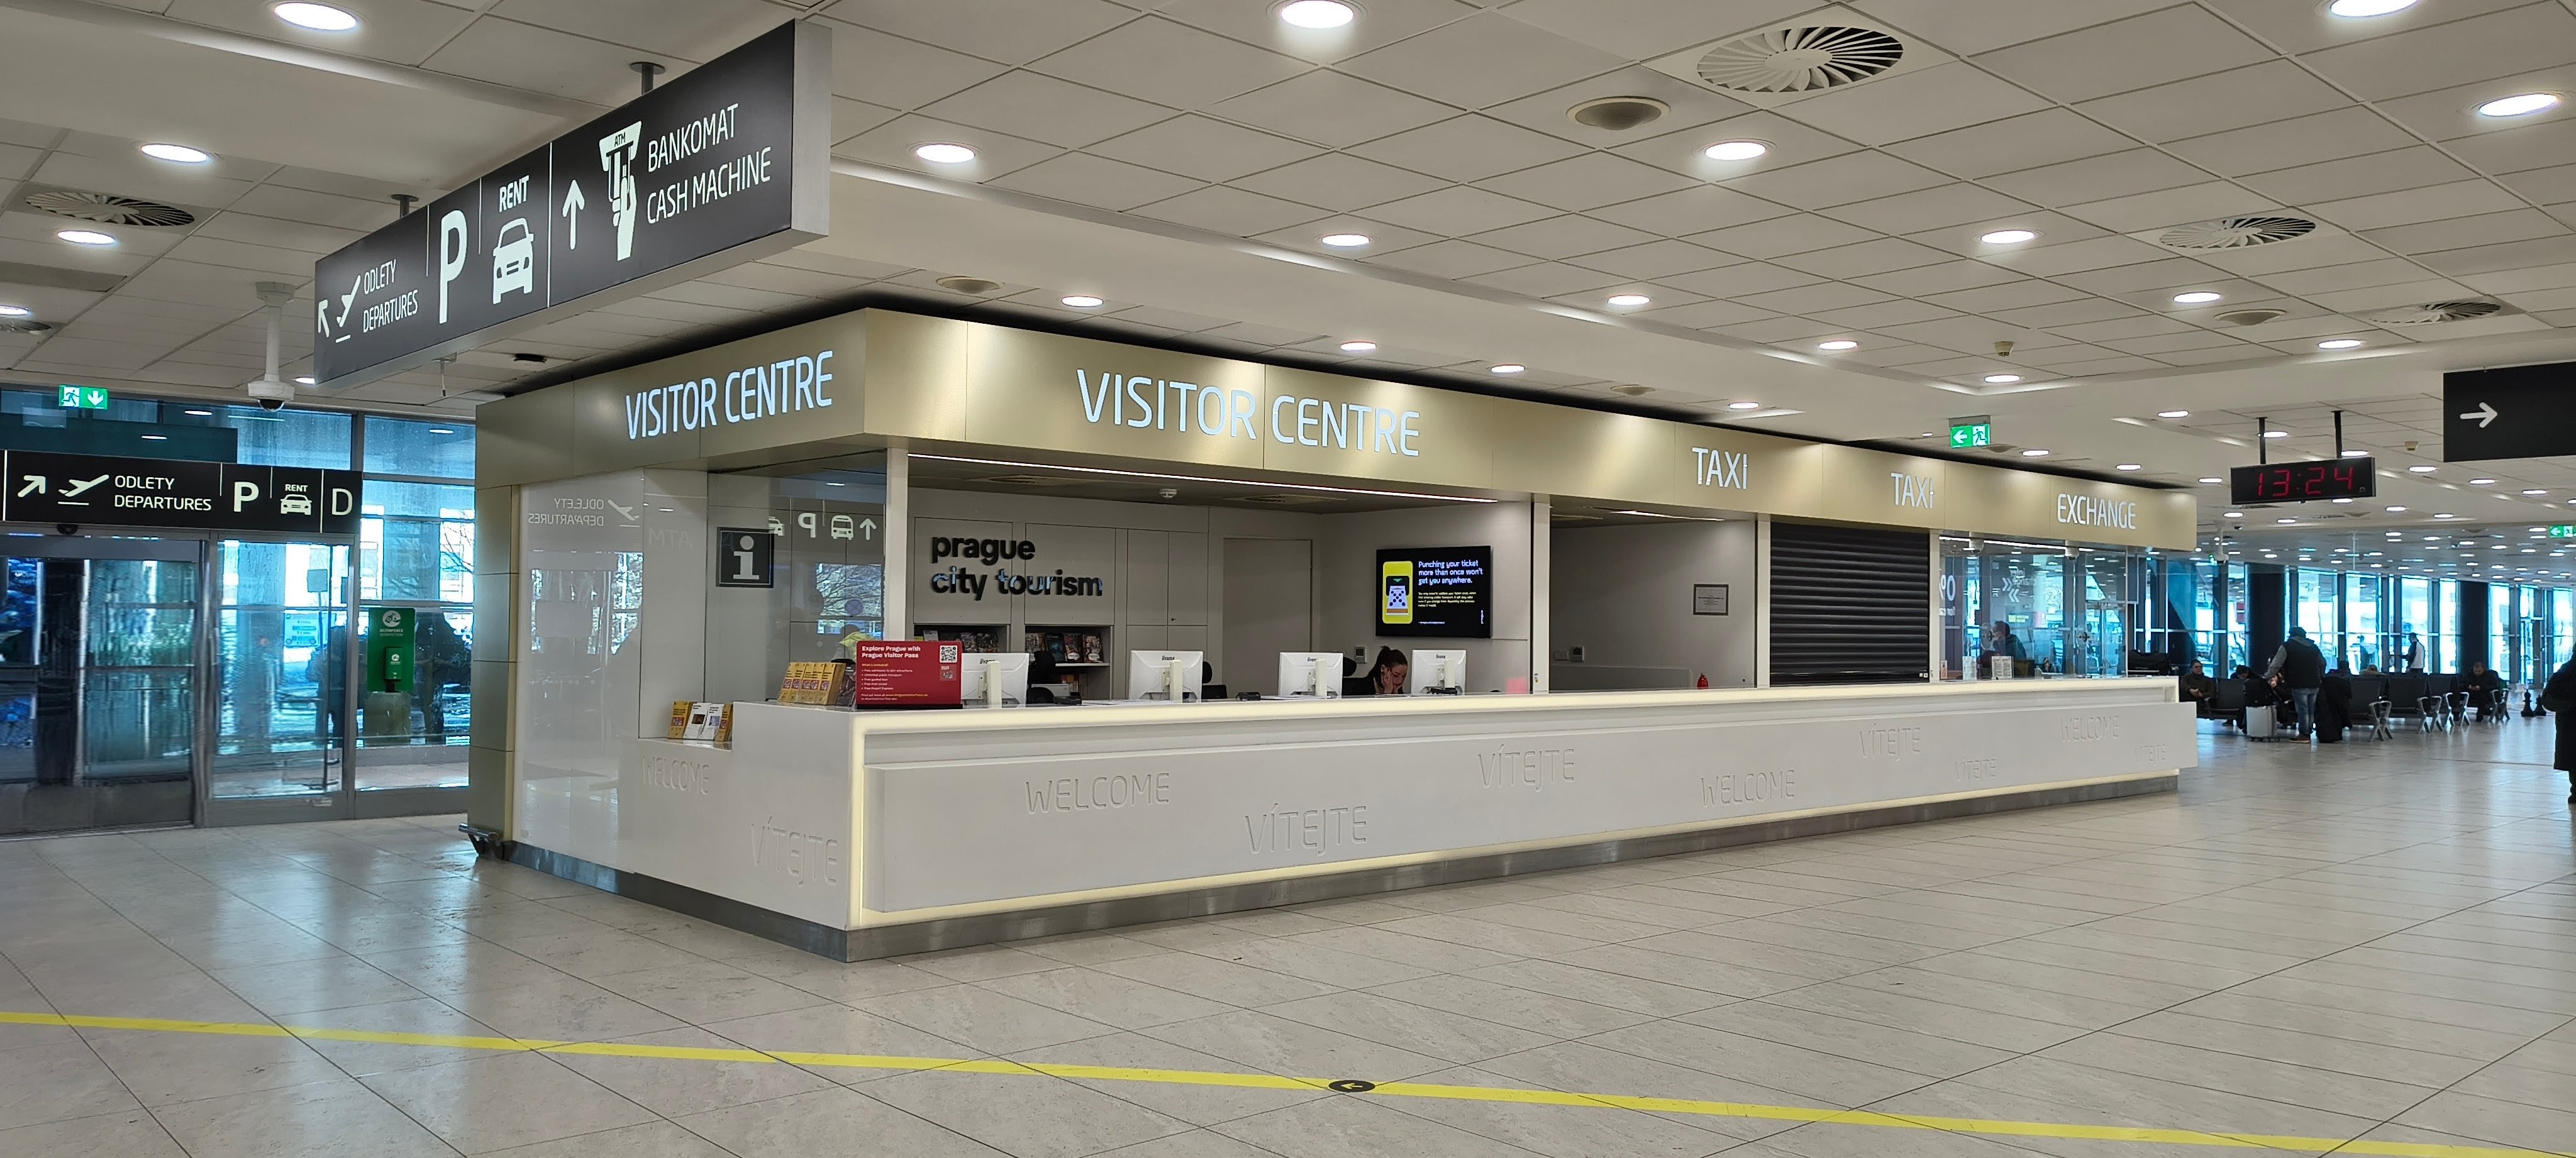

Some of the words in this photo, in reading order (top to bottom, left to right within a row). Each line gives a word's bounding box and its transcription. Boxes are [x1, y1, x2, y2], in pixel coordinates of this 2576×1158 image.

[614, 131, 626, 147] ATM
[648, 103, 738, 172] BANKOMAT
[499, 175, 530, 212] RENT
[647, 179, 688, 224] CASH
[692, 146, 771, 208] MACHINE
[364, 258, 396, 295] ODLETY
[440, 209, 467, 324] P
[363, 289, 418, 333] DEPARTURES
[625, 377, 717, 440] VISITOR
[724, 350, 834, 424] CENTRE
[1077, 368, 1257, 440] VISITOR
[1272, 395, 1421, 457] CENTRE
[114, 475, 175, 490] ODLETY
[1692, 447, 1748, 490] TAXI
[2257, 466, 2354, 497] 13:24
[114, 494, 212, 511] DEPARTURES
[233, 481, 259, 513] P
[285, 483, 308, 493] RENT
[331, 488, 353, 516] D
[1890, 473, 1935, 509] TAXI
[2057, 492, 2137, 529] EXCHANGE
[931, 536, 1035, 566] prague
[1418, 560, 1445, 569] Punching
[931, 566, 987, 601] city
[996, 568, 1103, 597] tourism
[1442, 576, 1472, 585] anywhere.
[1859, 723, 1921, 762] VÍTEJTE
[2059, 715, 2119, 743] WELCOME
[642, 755, 709, 795] WELCOME
[1477, 744, 1575, 792] VÍTEJTE
[1024, 773, 1170, 815] WELCOME
[1701, 769, 1795, 808] WELCOME
[1243, 802, 1367, 856] VÍTEJTE
[750, 815, 838, 888] VÍTEJTE
